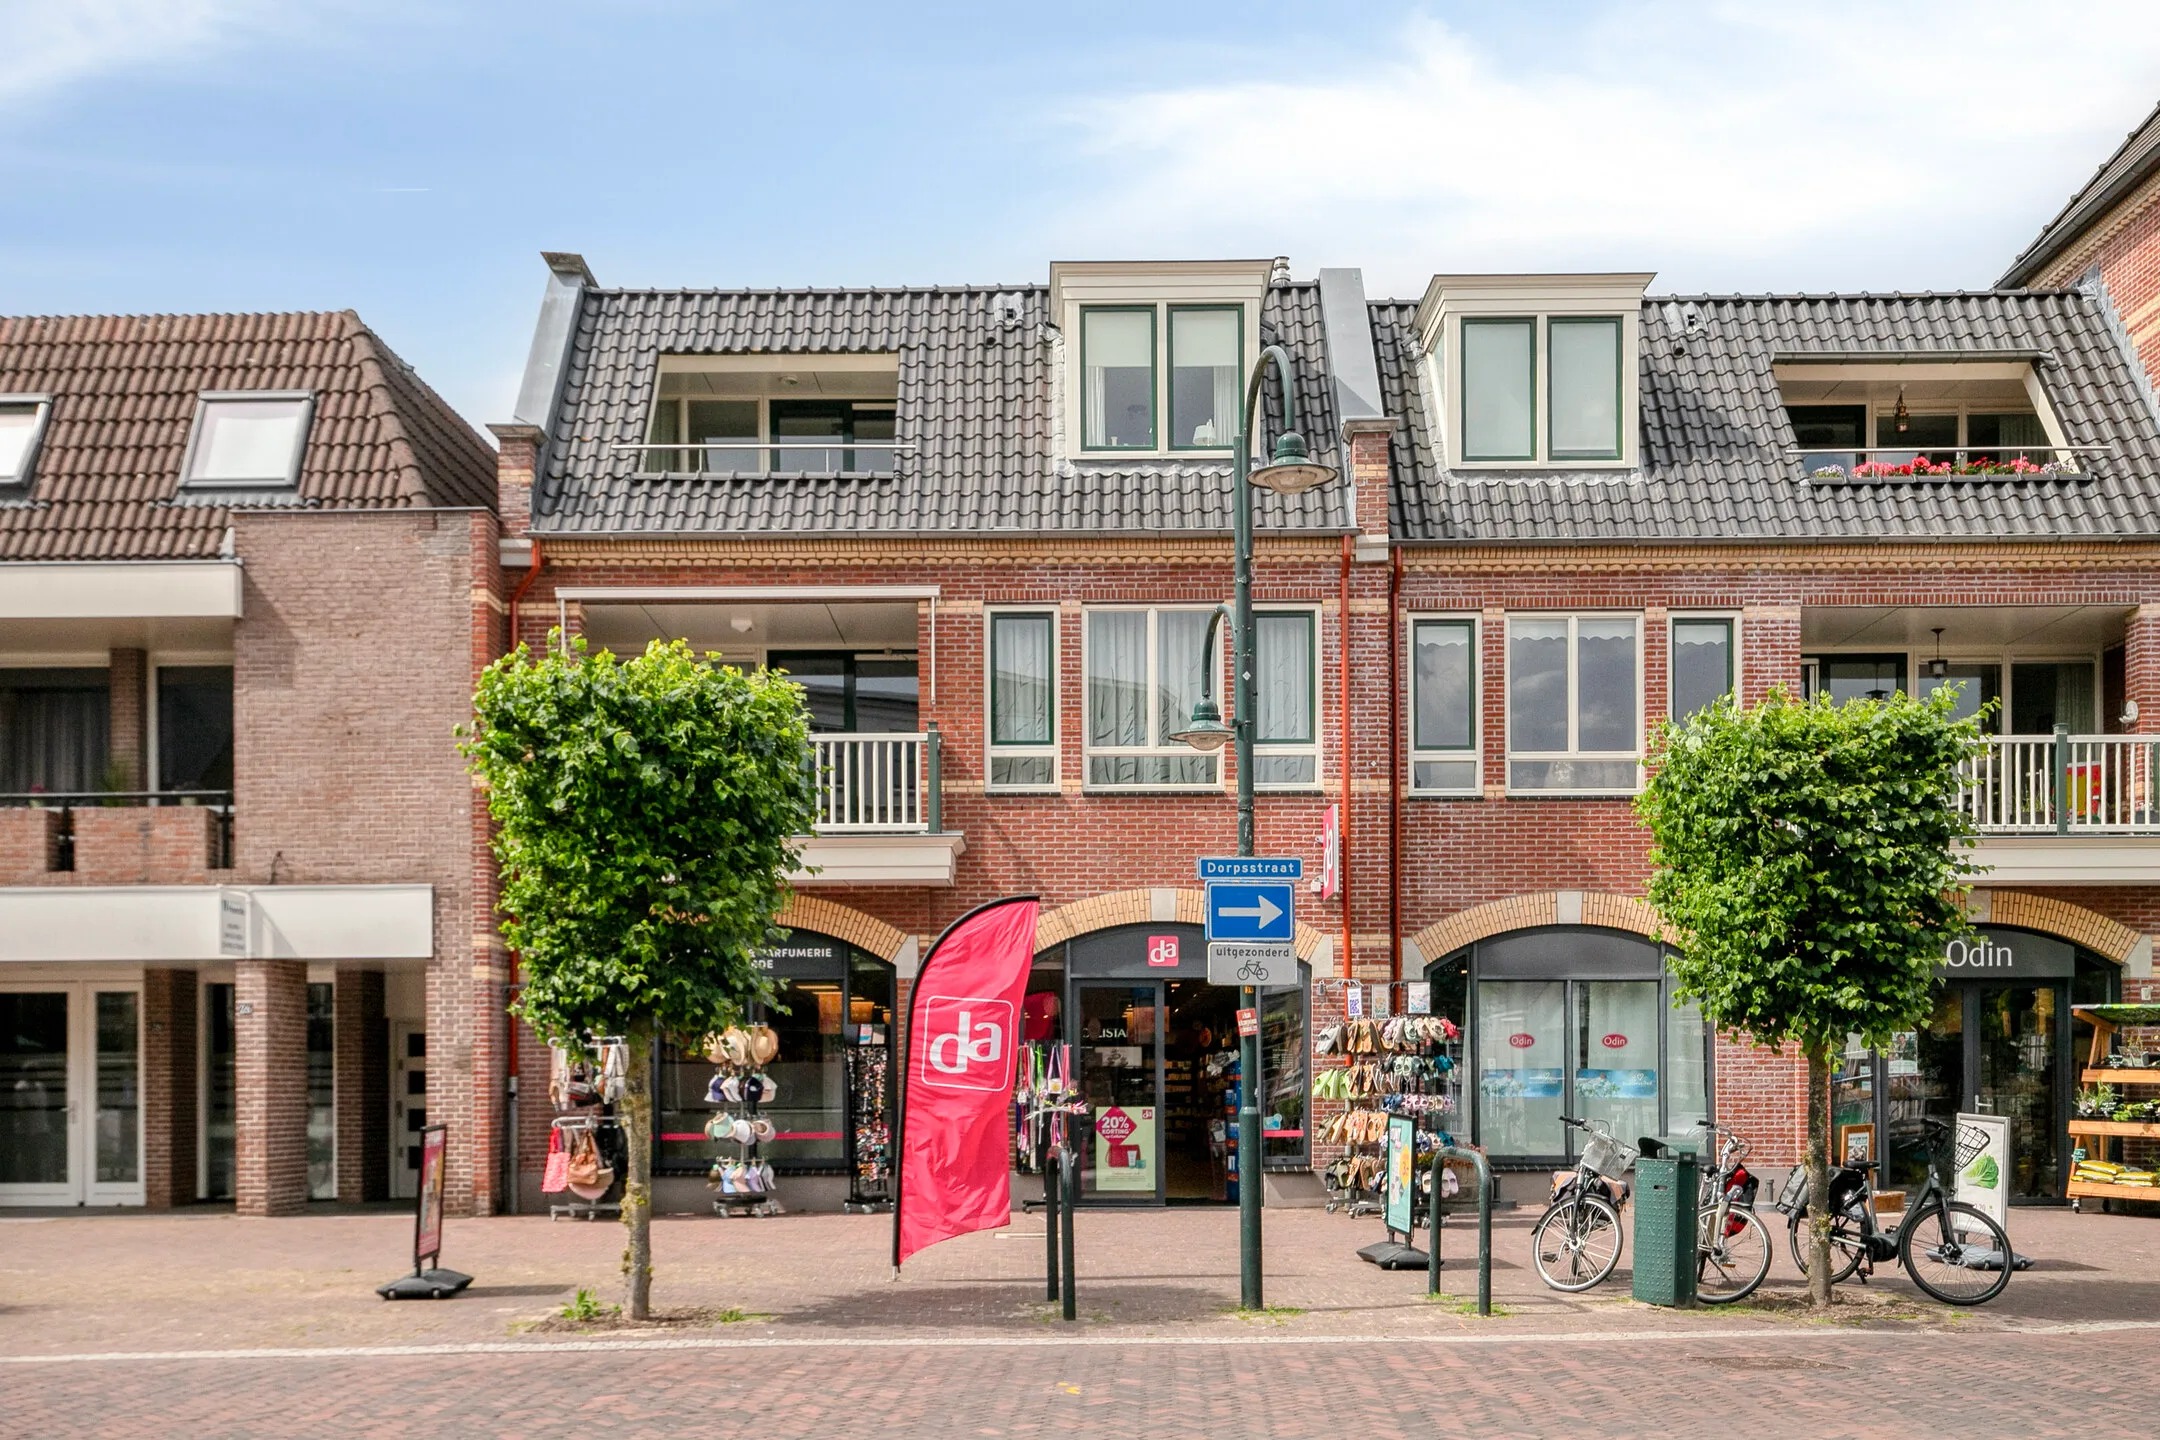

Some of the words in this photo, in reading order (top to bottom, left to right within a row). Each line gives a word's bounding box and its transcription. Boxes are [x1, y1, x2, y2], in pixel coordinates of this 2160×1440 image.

[1207, 862, 1294, 875] Dorpsstraat
[1150, 939, 1177, 963] da
[1216, 947, 1290, 959] uitgezonderd
[1946, 939, 2013, 967] Odin
[929, 1011, 1003, 1074] da
[1511, 1036, 1533, 1046] Odin
[1604, 1036, 1626, 1046] Odin
[1101, 1116, 1130, 1129] 20%
